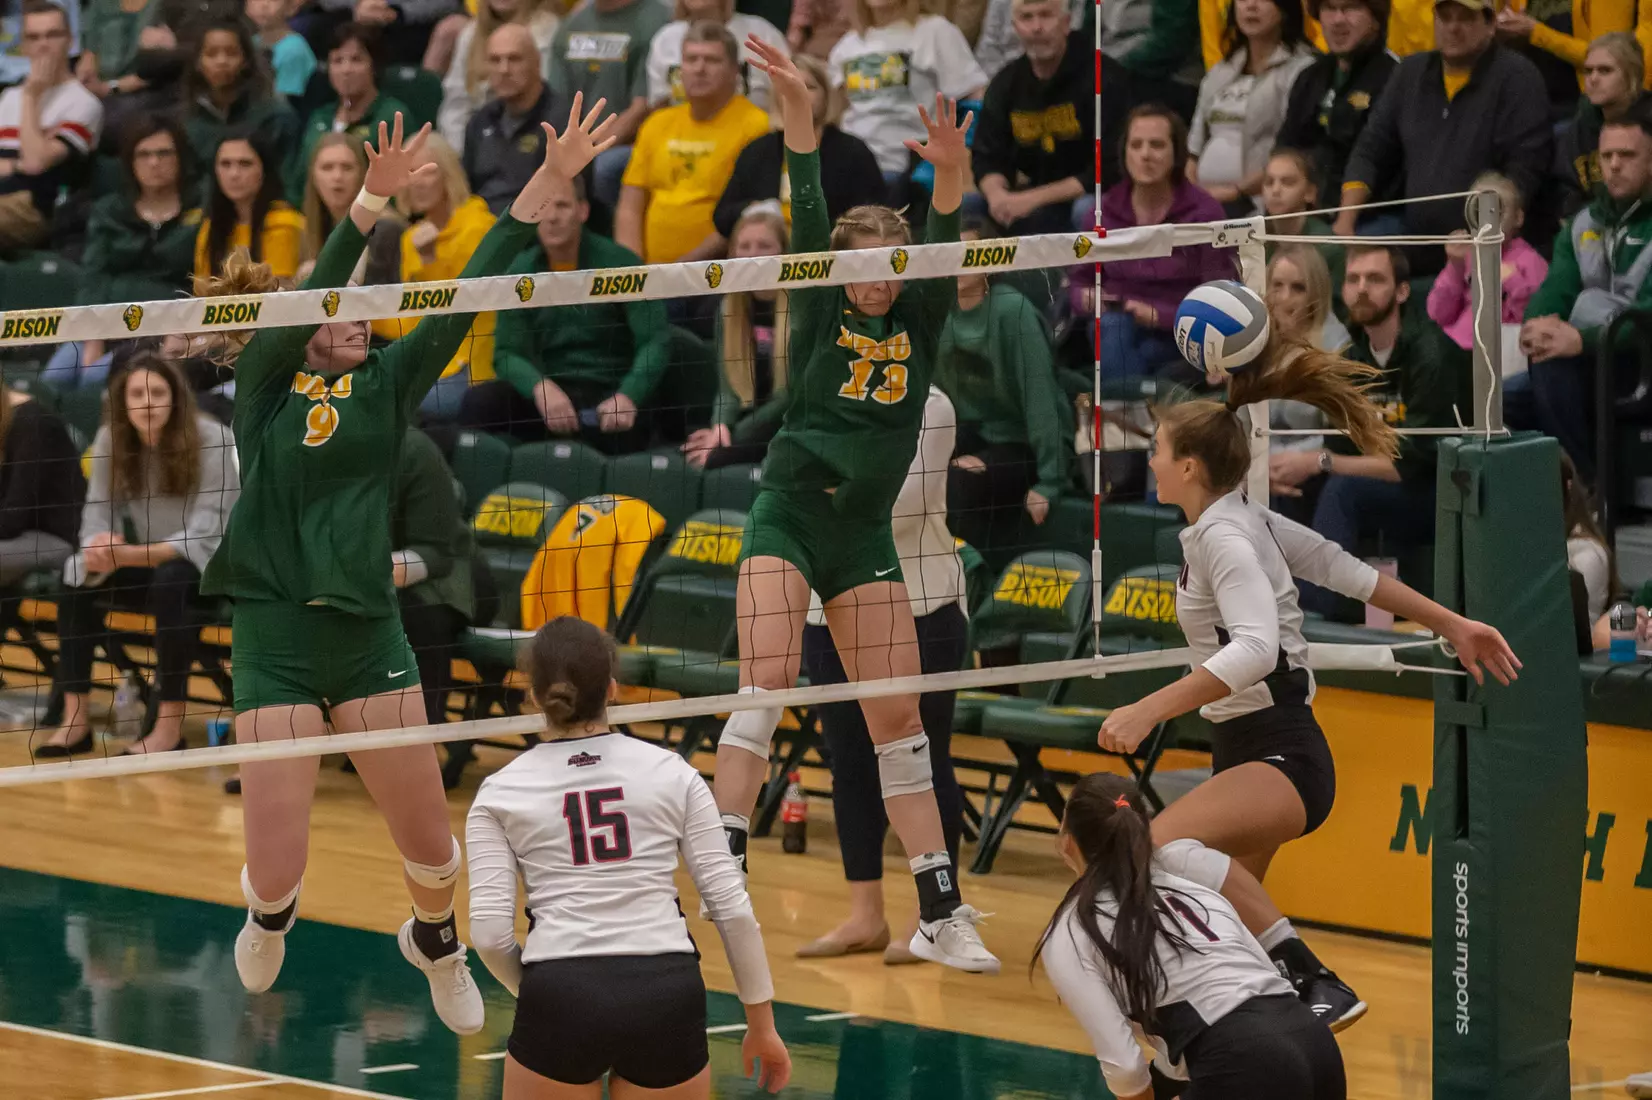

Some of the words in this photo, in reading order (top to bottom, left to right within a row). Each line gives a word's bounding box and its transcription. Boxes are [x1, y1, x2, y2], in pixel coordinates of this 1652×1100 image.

[777, 259, 835, 283] BISON
[961, 245, 1017, 268] BISON
[398, 287, 458, 312] BISON
[589, 273, 648, 296] BISON
[0, 315, 61, 339] BISON
[201, 301, 262, 325] BISON
[838, 360, 908, 405] 13
[302, 403, 339, 447] 9
[668, 528, 743, 566] BISON
[994, 571, 1074, 609] BISON
[1104, 583, 1178, 624] BISO
[563, 787, 632, 865] 15
[1164, 896, 1221, 942] 1
[1453, 861, 1469, 939] sports
[1452, 941, 1469, 1035] imports
